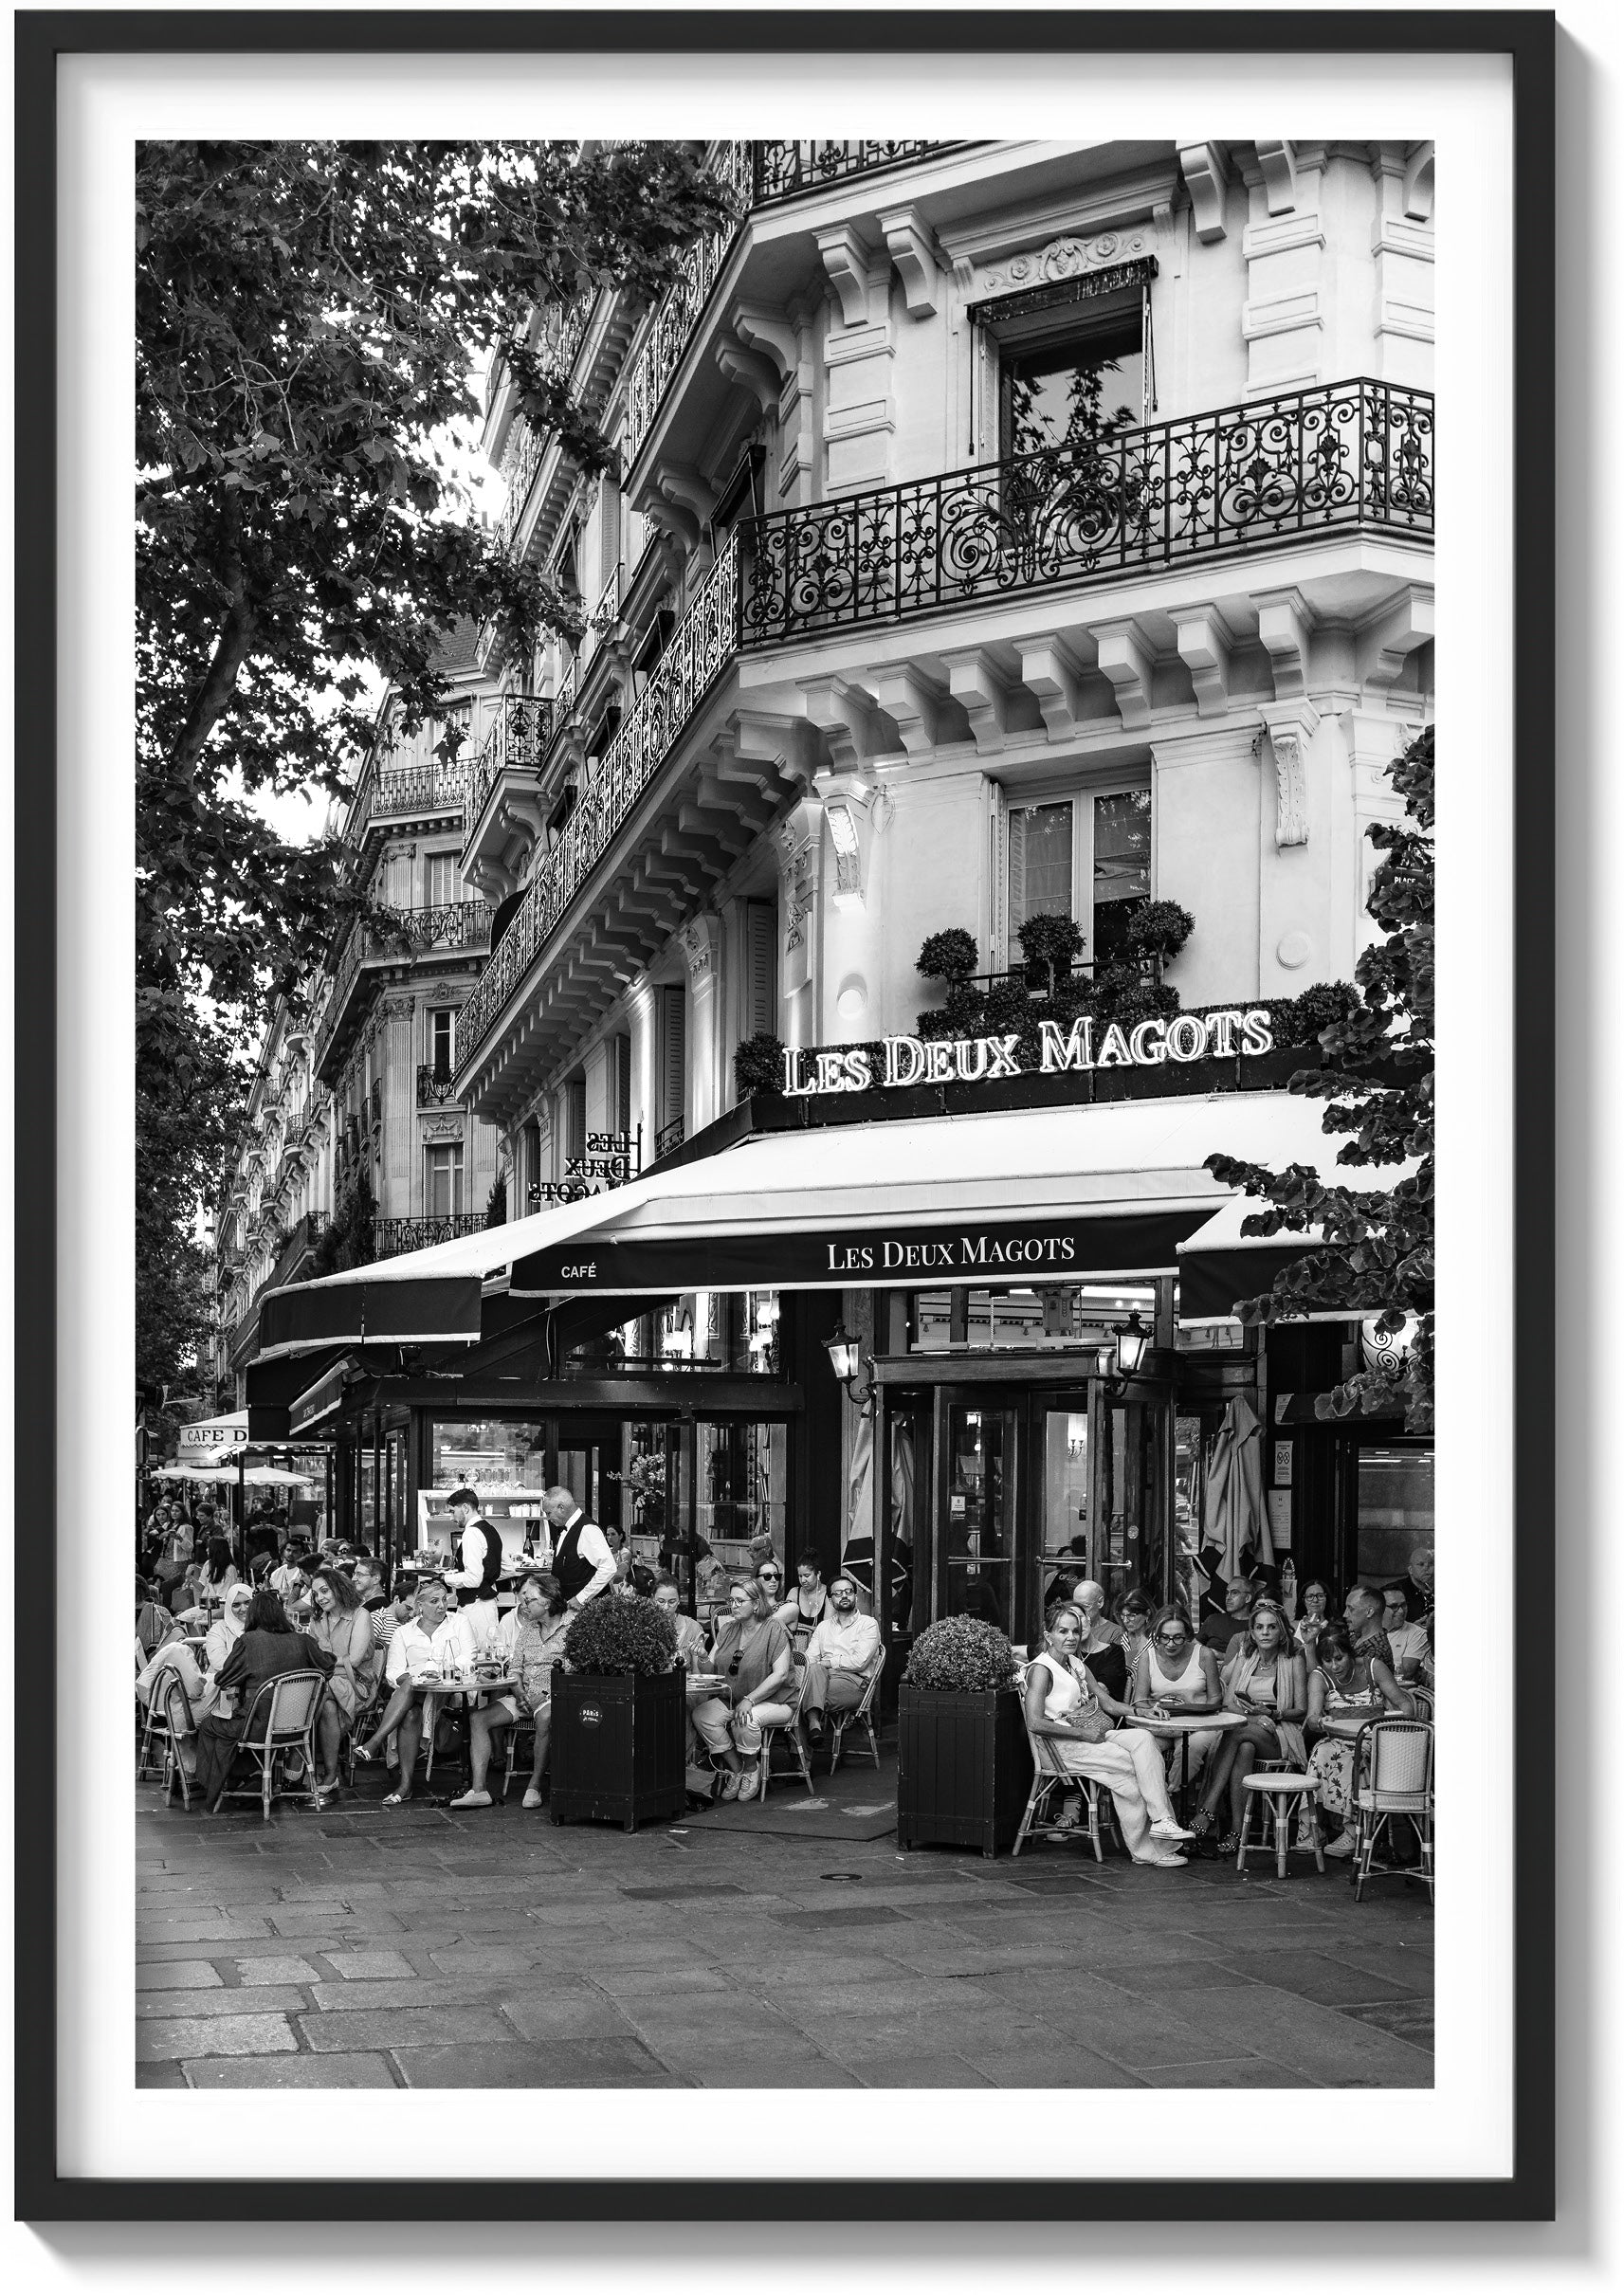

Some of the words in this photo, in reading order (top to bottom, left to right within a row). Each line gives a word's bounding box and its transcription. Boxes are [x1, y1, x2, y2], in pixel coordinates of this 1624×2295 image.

[782, 1047, 872, 1096] LES
[884, 1034, 1022, 1086] DEUX
[1038, 1010, 1274, 1072] MAGOTS
[827, 1244, 874, 1269] LES
[883, 1241, 955, 1268] DEUX
[960, 1236, 1075, 1264] MAGOTS
[561, 1262, 596, 1278] CAFÉ
[188, 1430, 224, 1442] CAFE
